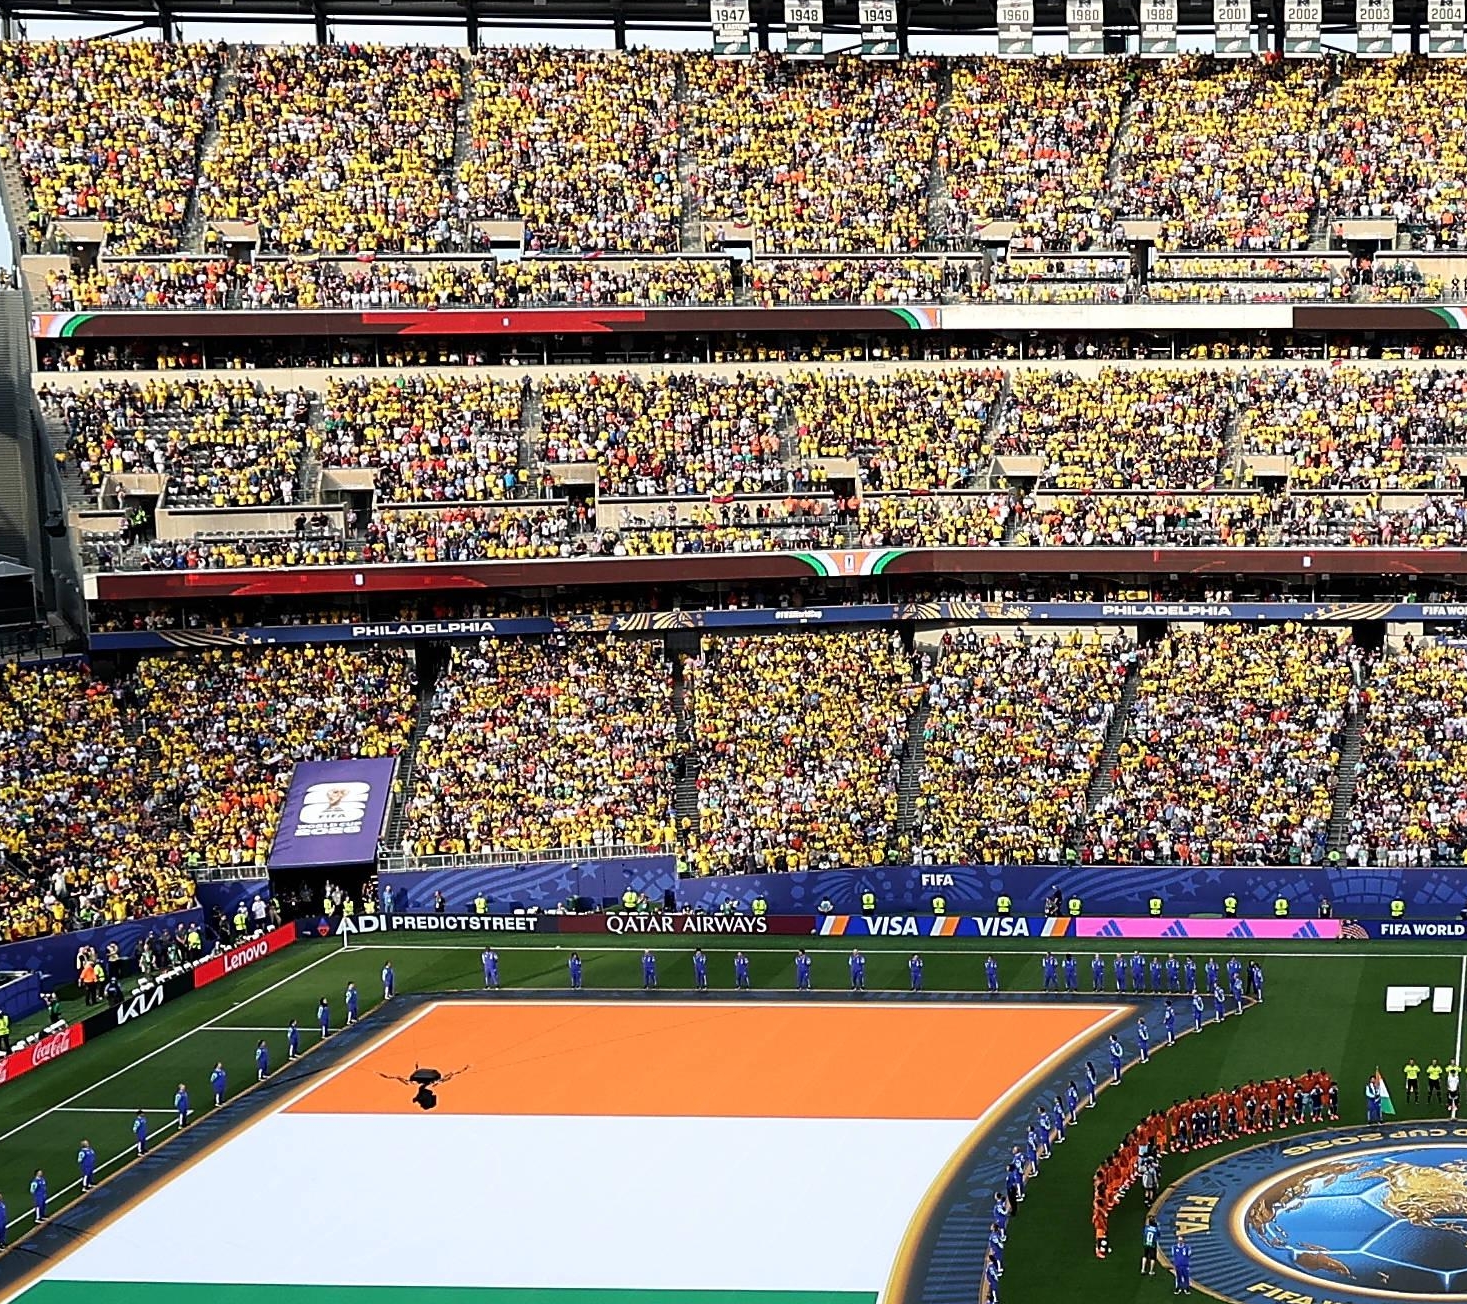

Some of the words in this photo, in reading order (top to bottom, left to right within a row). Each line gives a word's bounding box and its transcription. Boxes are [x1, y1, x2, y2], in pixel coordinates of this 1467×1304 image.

[716, 10, 745, 22] 1947
[790, 10, 819, 22] 1948
[864, 9, 892, 22] 1949
[1002, 10, 1029, 22] 1960
[1071, 9, 1099, 21] 1980
[1146, 9, 1173, 21] 1988
[1219, 8, 1247, 21] 2001
[1288, 8, 1318, 20] 2002
[1360, 8, 1390, 21] 2003
[1432, 8, 1462, 20] 2004
[1103, 606, 1231, 616] PHILADELPHIA
[1422, 606, 1445, 616] FIFA
[353, 621, 495, 636] PHILADELPHIA
[294, 826, 361, 836] 2026
[922, 874, 953, 886] FIFA
[336, 915, 386, 935] ADI
[392, 915, 538, 931] PREDICTSTREET
[606, 916, 674, 934] QATAR
[683, 916, 767, 933] AIRWAYS
[865, 917, 918, 935] VISA
[972, 917, 1029, 935] VISA
[1382, 924, 1411, 936] FIFA
[1413, 924, 1464, 936] WORLD
[224, 941, 268, 968] Lenovo
[1175, 1195, 1220, 1235] FIFA
